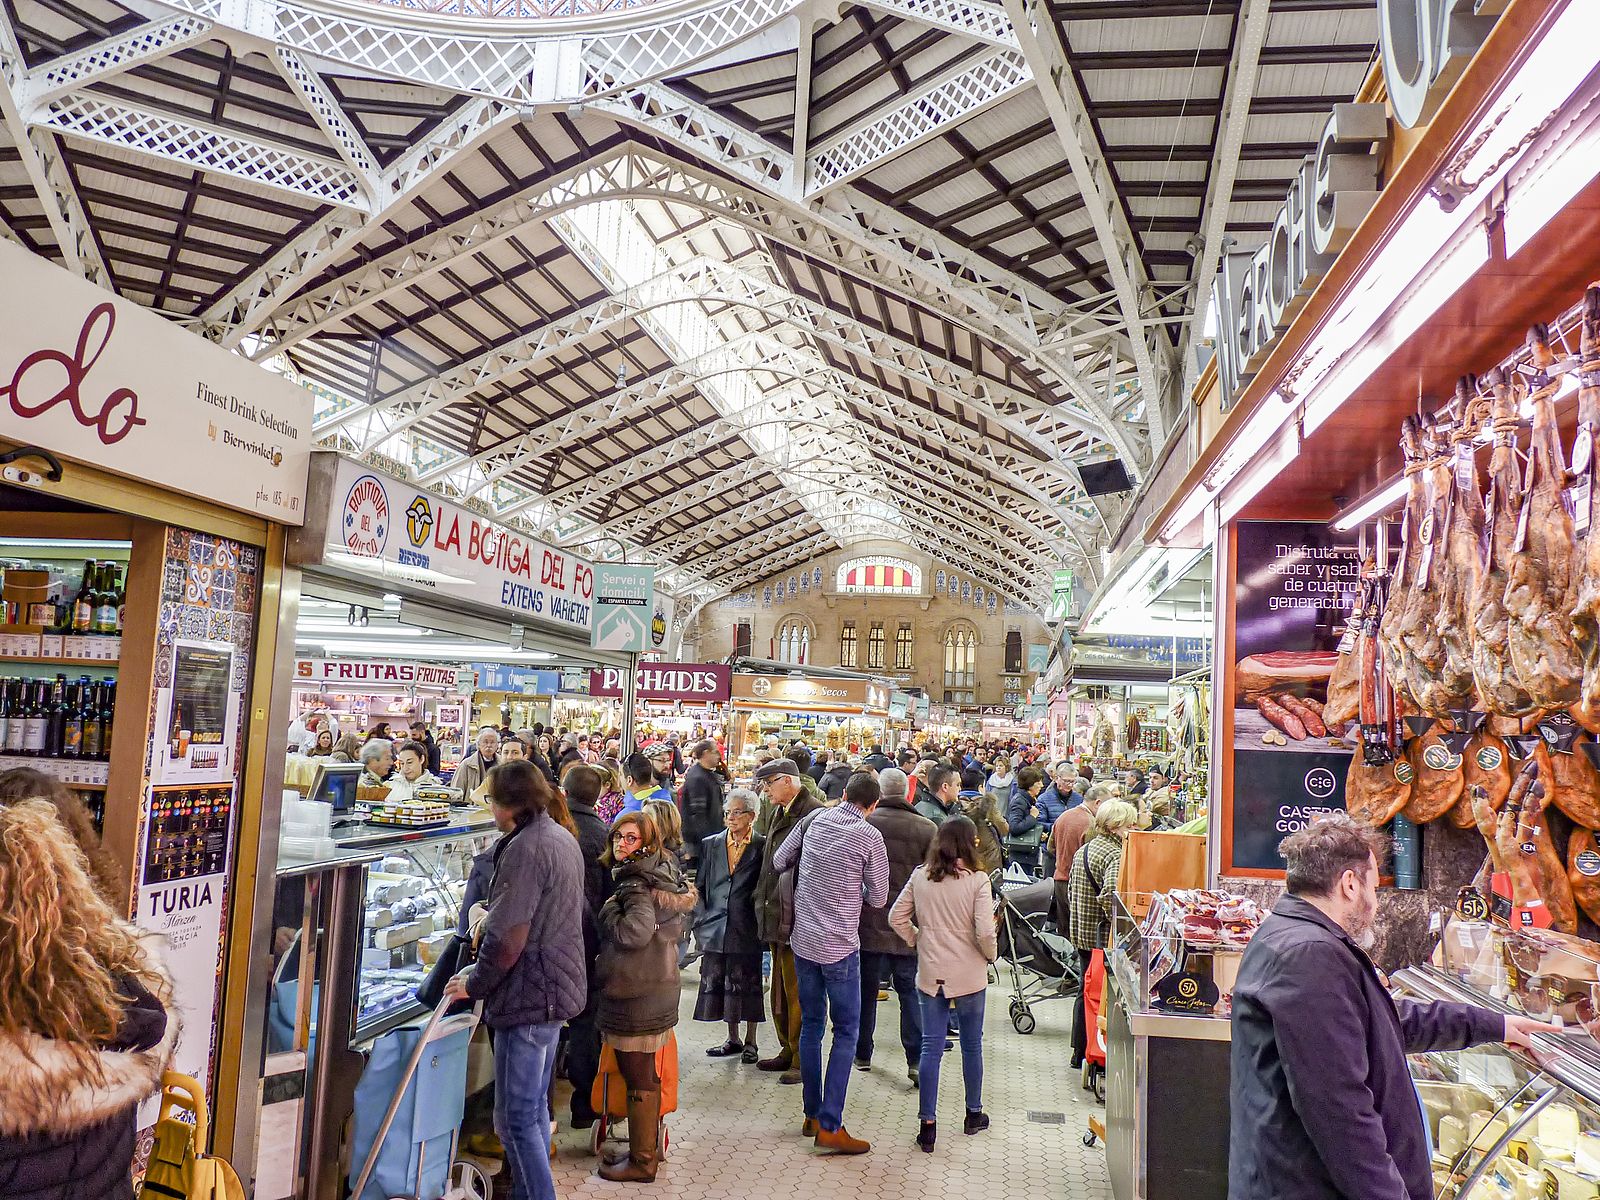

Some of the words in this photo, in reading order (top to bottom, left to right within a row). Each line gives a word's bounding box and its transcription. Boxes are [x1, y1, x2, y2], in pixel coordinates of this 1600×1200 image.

[196, 381, 228, 410] Finest
[229, 396, 257, 423] Drink
[259, 409, 298, 440] Selection
[223, 429, 274, 461] Bierwinkel
[349, 481, 387, 519] BOUTIQUE
[360, 514, 371, 532] DEL
[434, 507, 461, 555] LA
[467, 520, 532, 580] BOTIGA
[540, 550, 566, 591] DEL
[573, 562, 593, 599] FO
[1275, 544, 1339, 559] Disfruta
[602, 572, 636, 585] Servei
[639, 577, 646, 586] a
[1267, 562, 1313, 576] saber
[1315, 564, 1327, 578] y
[1330, 562, 1358, 576] sab
[601, 585, 646, 599] domicili
[1284, 577, 1304, 592] de
[1307, 579, 1358, 593] cuatro
[501, 580, 544, 613] EXTENS
[550, 594, 590, 626] VARIETAT
[1268, 595, 1355, 610] generacion
[323, 662, 414, 680] FRUTAS
[416, 666, 456, 684] FRUTAS
[821, 686, 848, 697] Secos
[150, 882, 212, 916] TURIA
